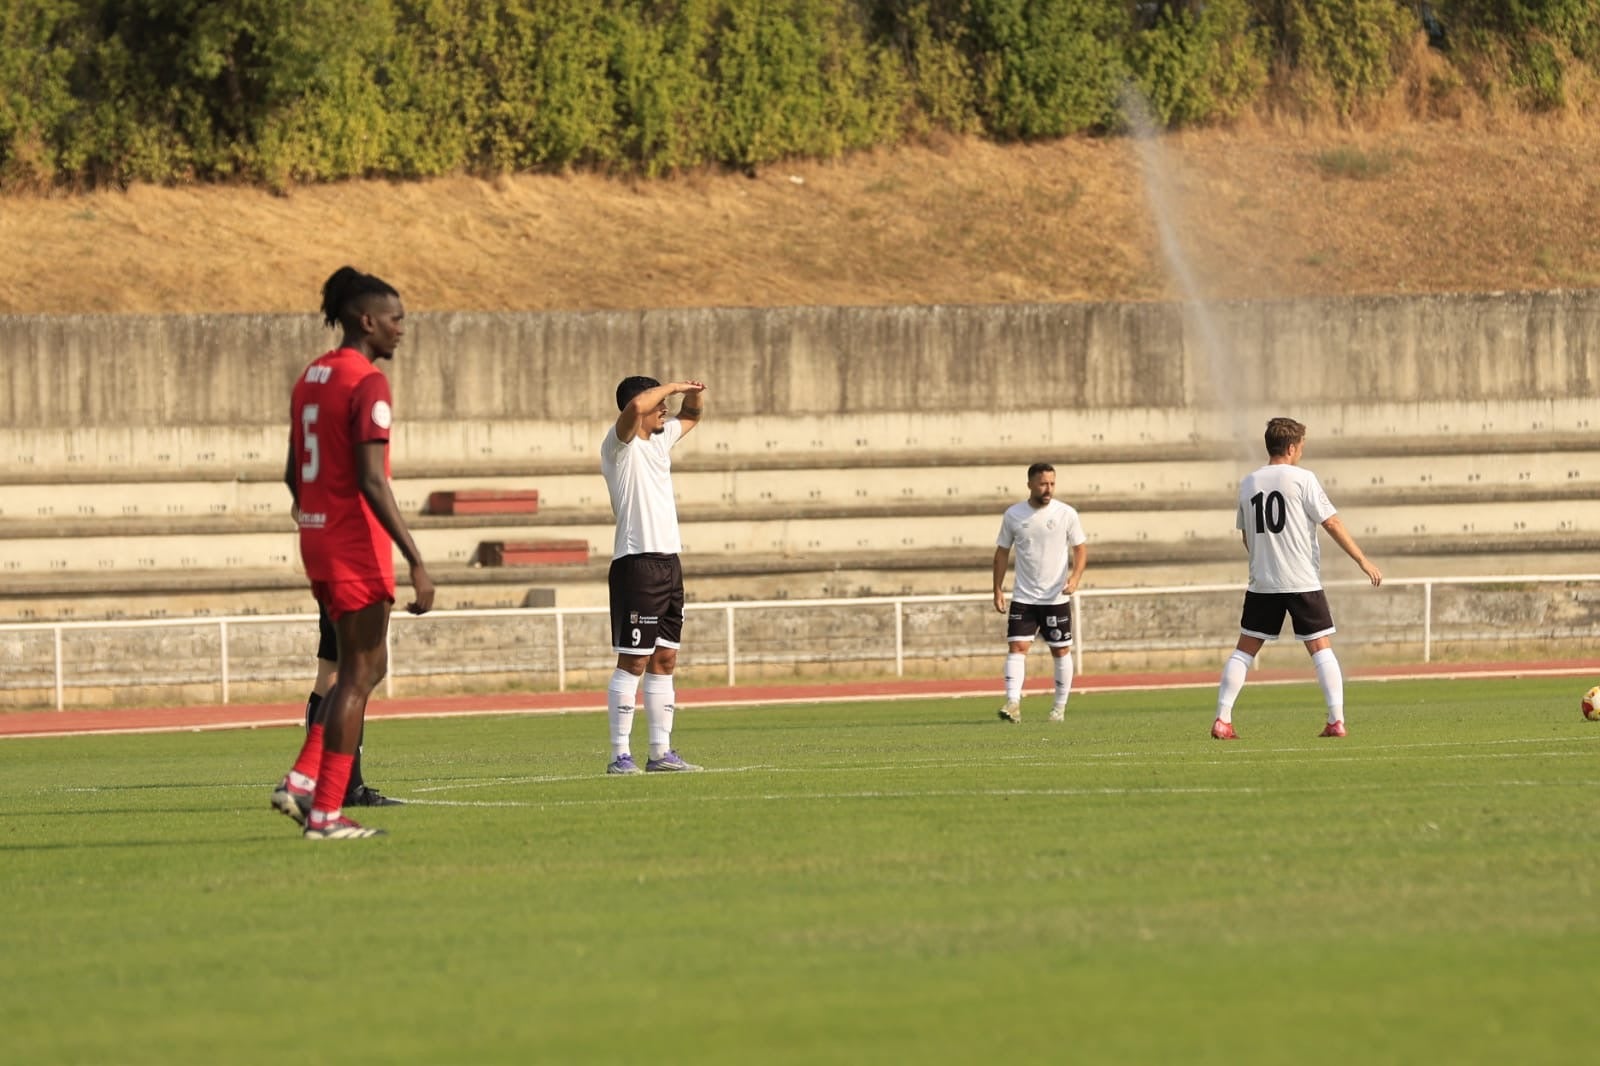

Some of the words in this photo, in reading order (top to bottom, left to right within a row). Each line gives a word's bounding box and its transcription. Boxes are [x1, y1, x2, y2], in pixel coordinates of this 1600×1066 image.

[302, 404, 320, 483] 5
[1250, 490, 1286, 534] 10
[631, 628, 642, 647] 9
